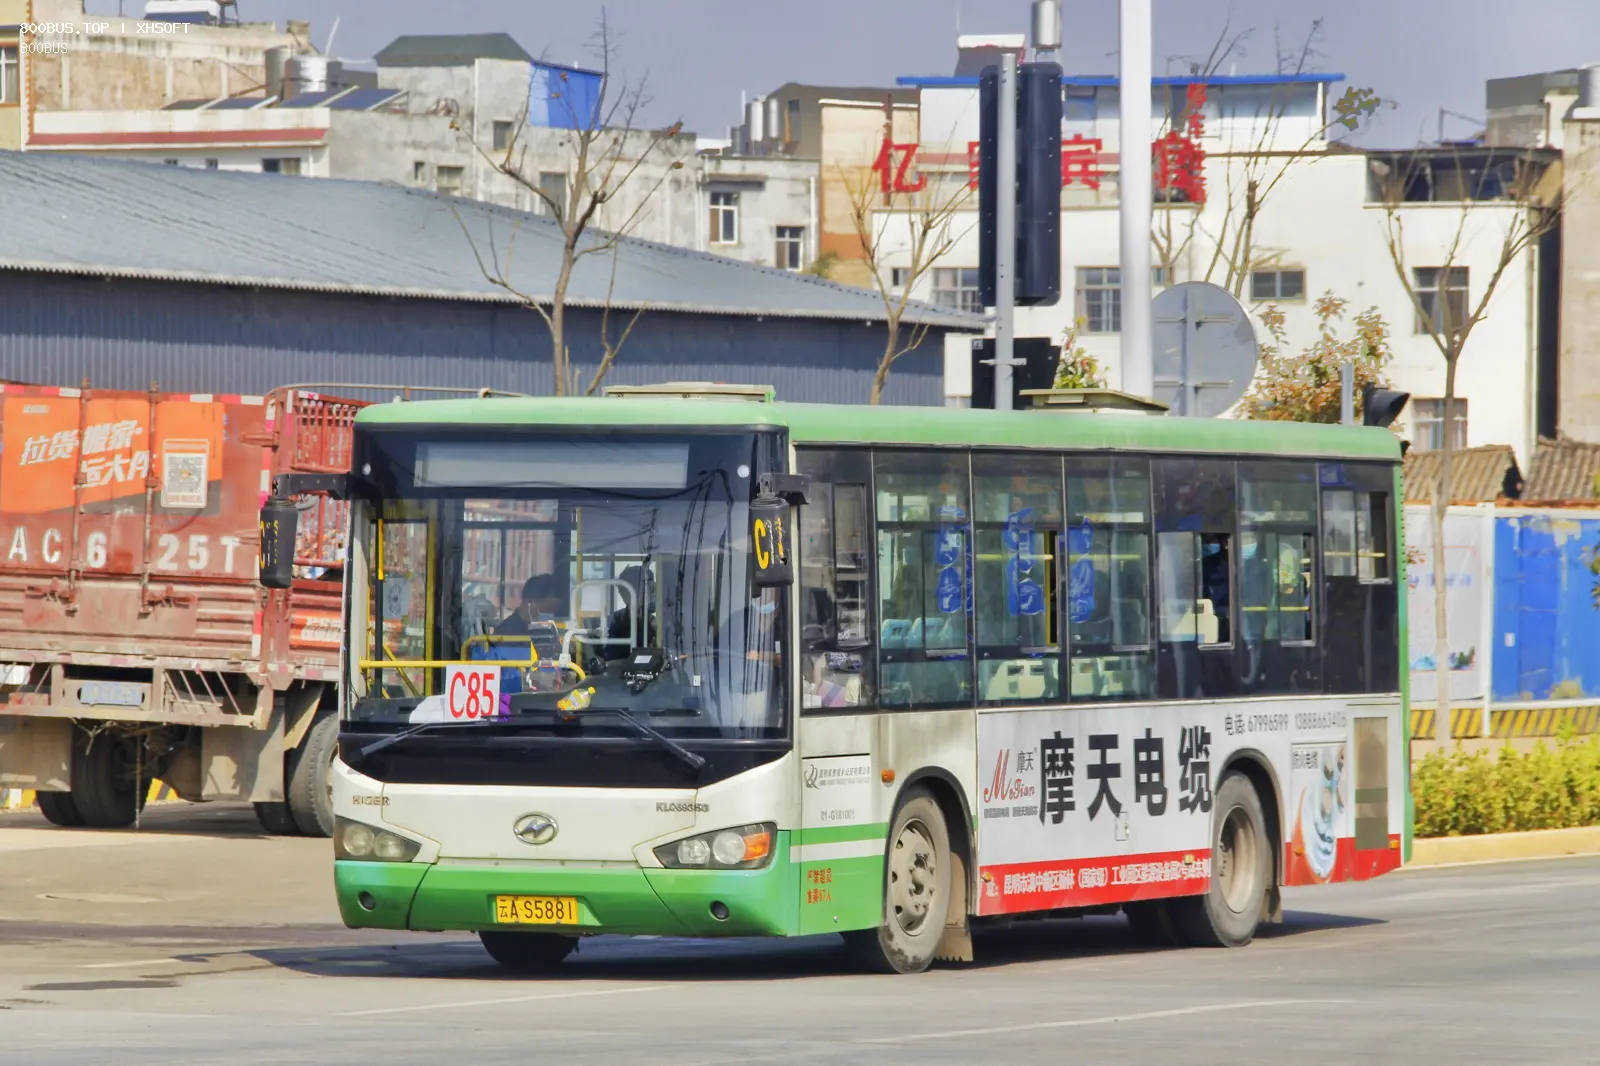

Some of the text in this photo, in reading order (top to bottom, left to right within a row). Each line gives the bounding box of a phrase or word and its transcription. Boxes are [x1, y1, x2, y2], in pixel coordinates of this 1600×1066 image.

[450, 671, 495, 719] C85
[1039, 725, 1212, 827] 摩天电缆
[352, 795, 391, 806] HIGER
